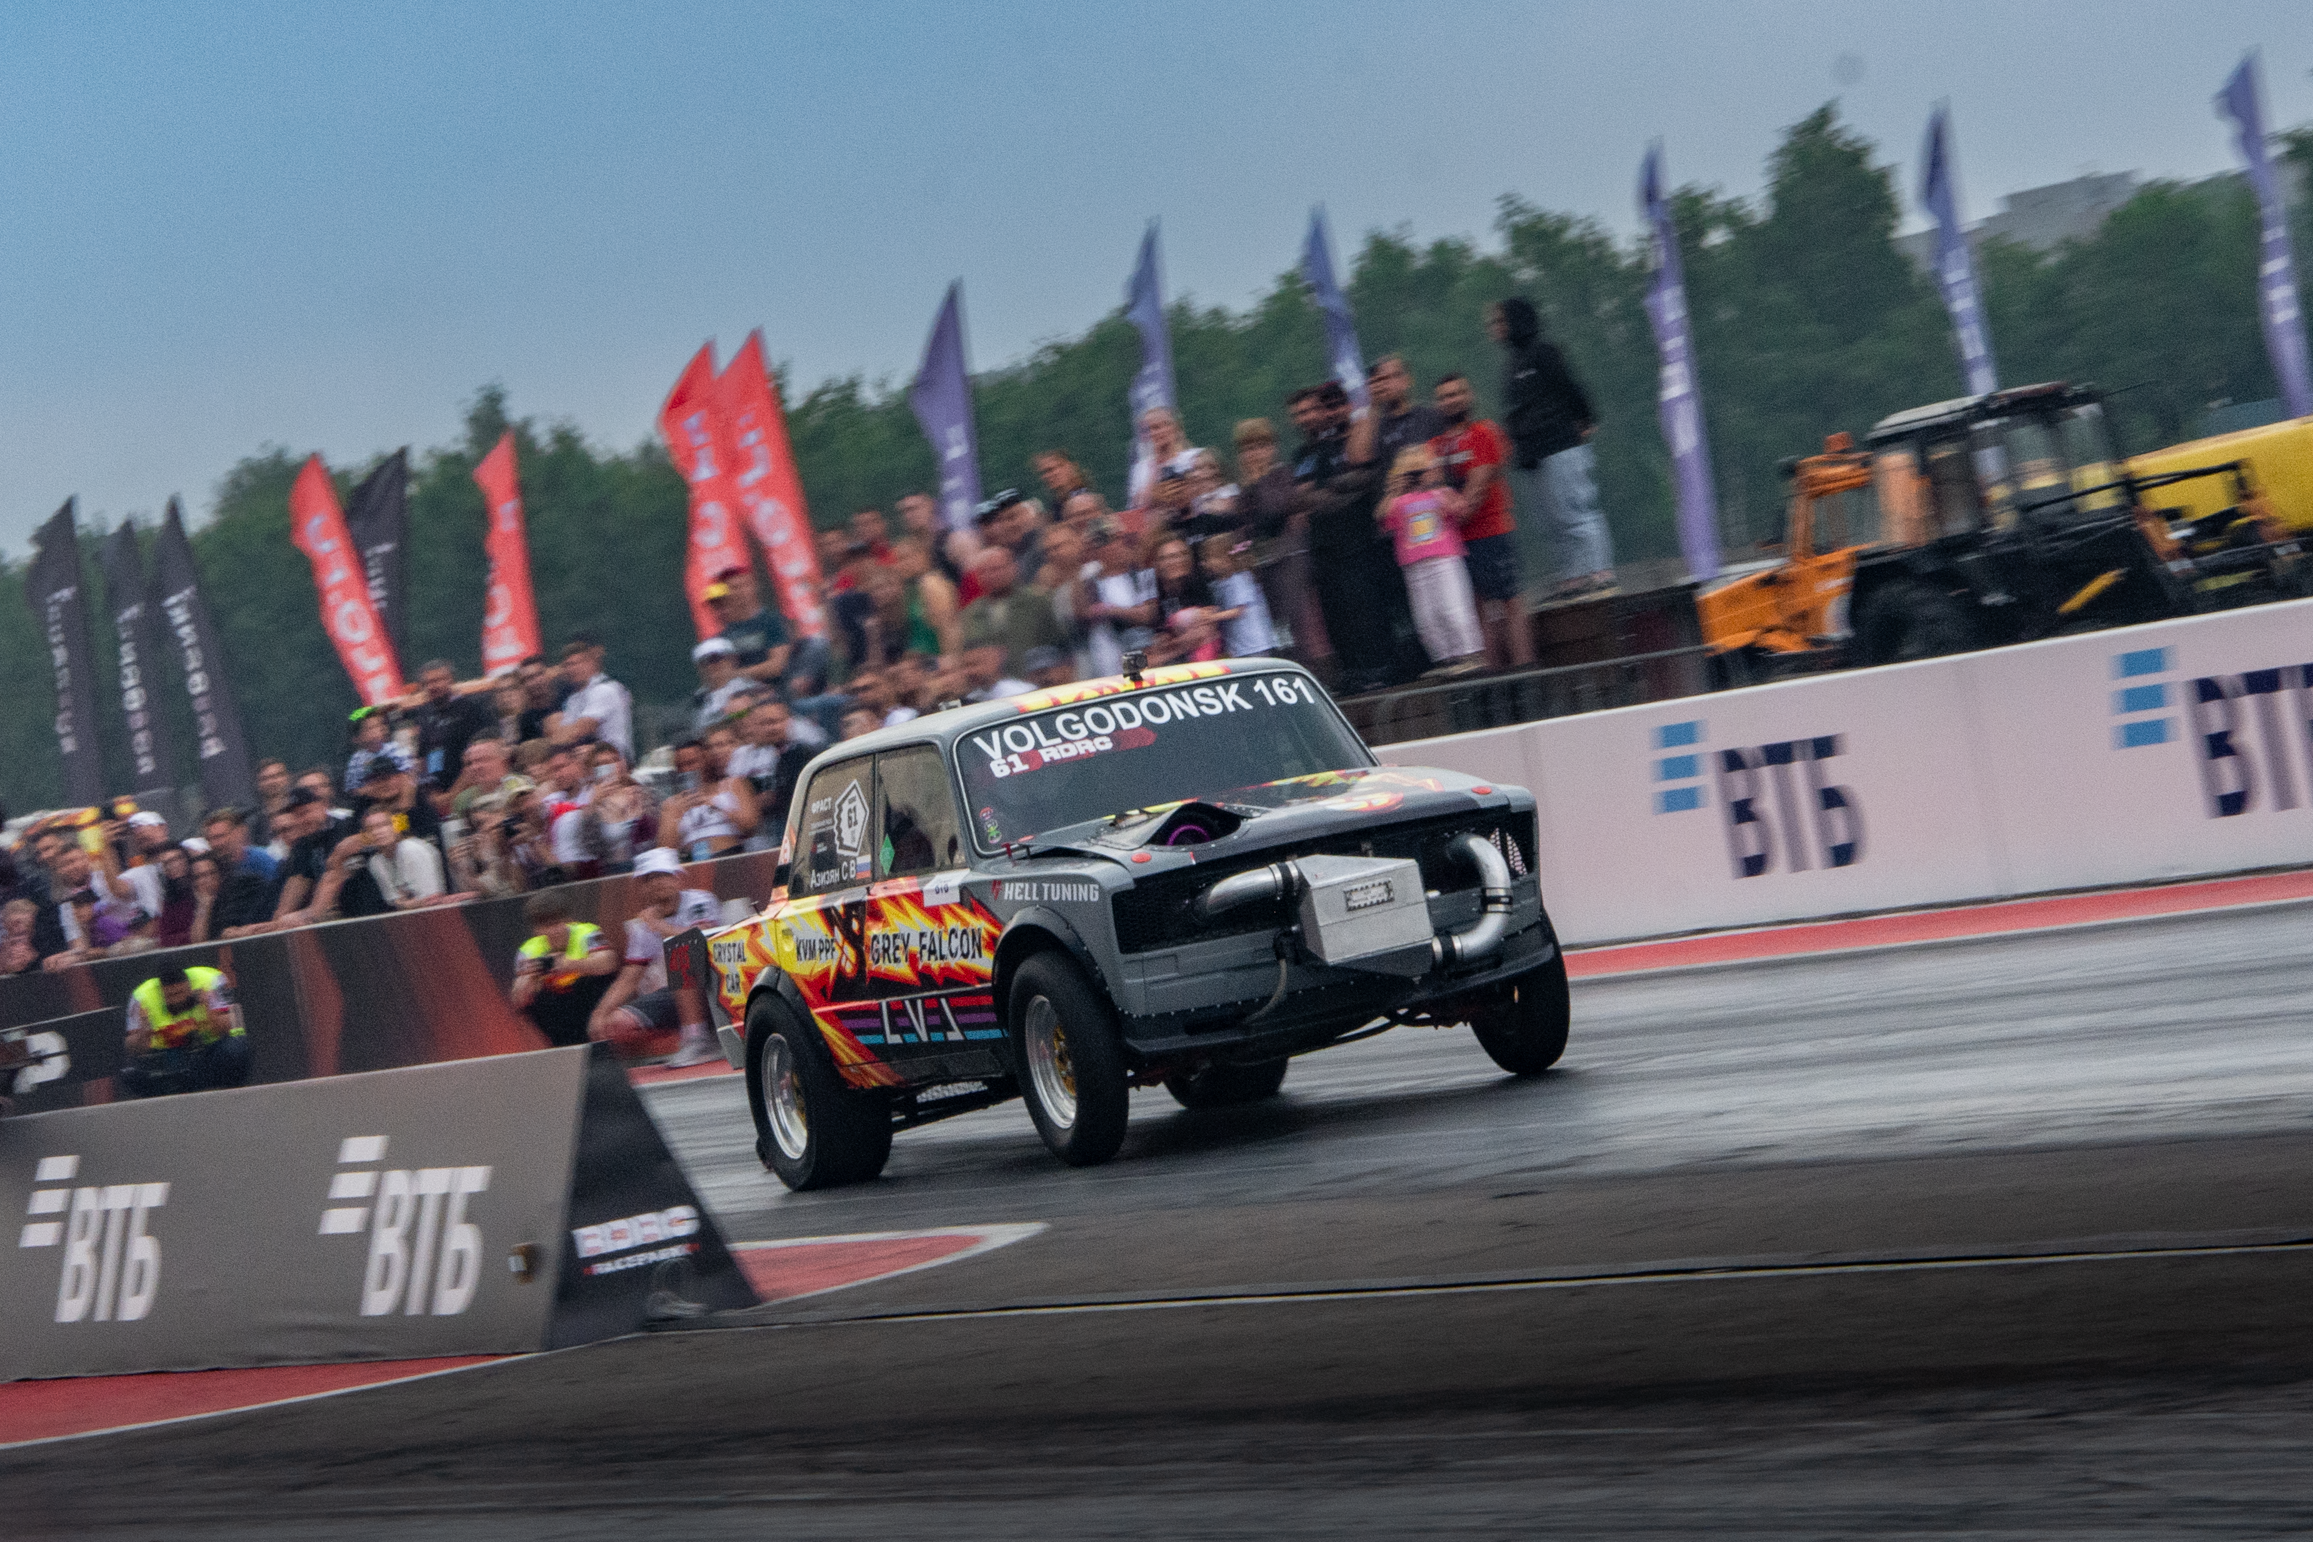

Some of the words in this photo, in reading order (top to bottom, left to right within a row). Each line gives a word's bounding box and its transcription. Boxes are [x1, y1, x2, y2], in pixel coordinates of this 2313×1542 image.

[973, 683, 1252, 760] VOLGODONSK
[1253, 676, 1316, 709] 161
[989, 753, 1030, 778] 61
[1004, 883, 1038, 900] HELL
[1042, 883, 1100, 901] TUNING
[712, 940, 747, 963] CRYSTAL
[870, 928, 910, 965] GREY
[919, 927, 983, 962] FALCON
[726, 973, 741, 994] CAR
